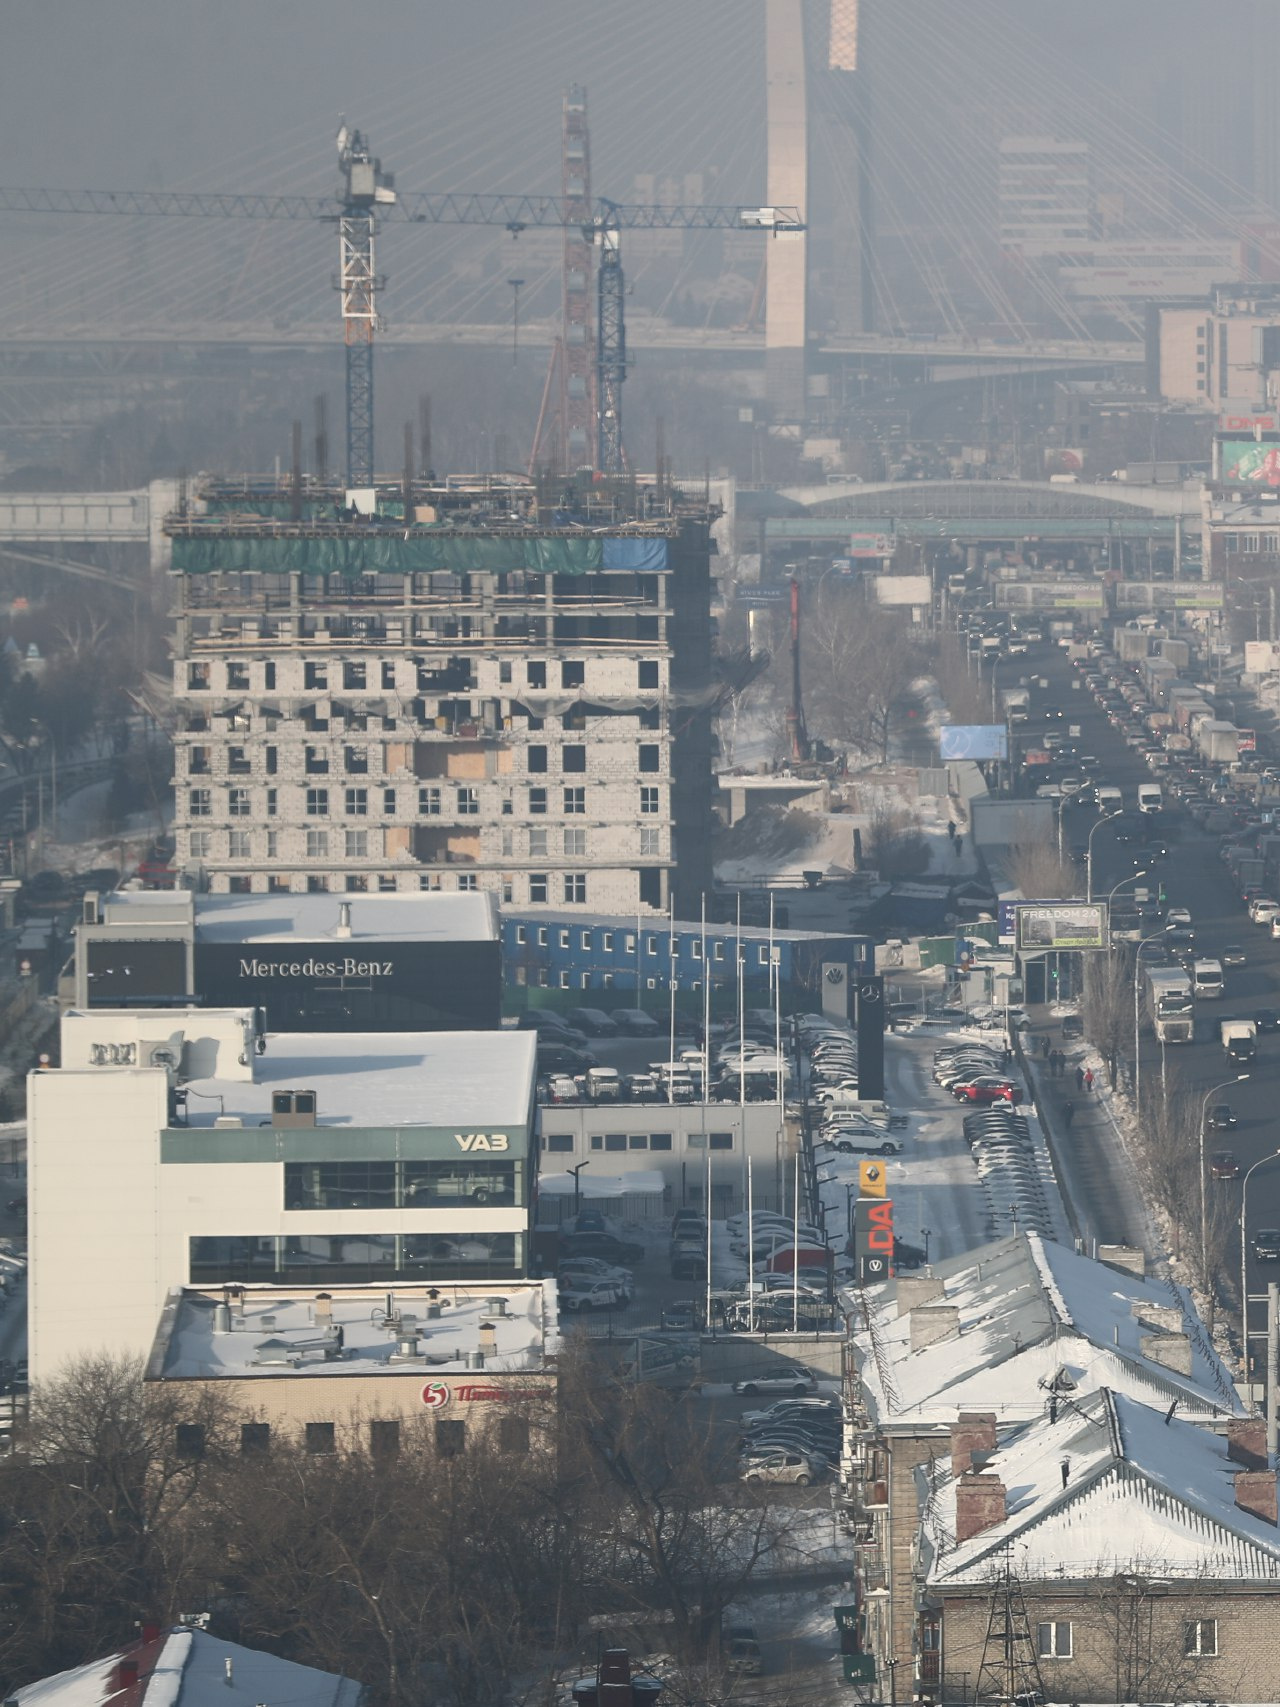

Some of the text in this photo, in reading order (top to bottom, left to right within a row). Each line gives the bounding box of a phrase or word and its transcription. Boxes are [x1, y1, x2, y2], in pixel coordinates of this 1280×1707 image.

[1226, 417, 1275, 430] DNS
[1022, 909, 1098, 919] FREEDOM 2.0
[239, 958, 394, 977] Mercedes-Benz
[454, 1134, 509, 1152] УАЗ
[868, 1199, 895, 1278] DA
